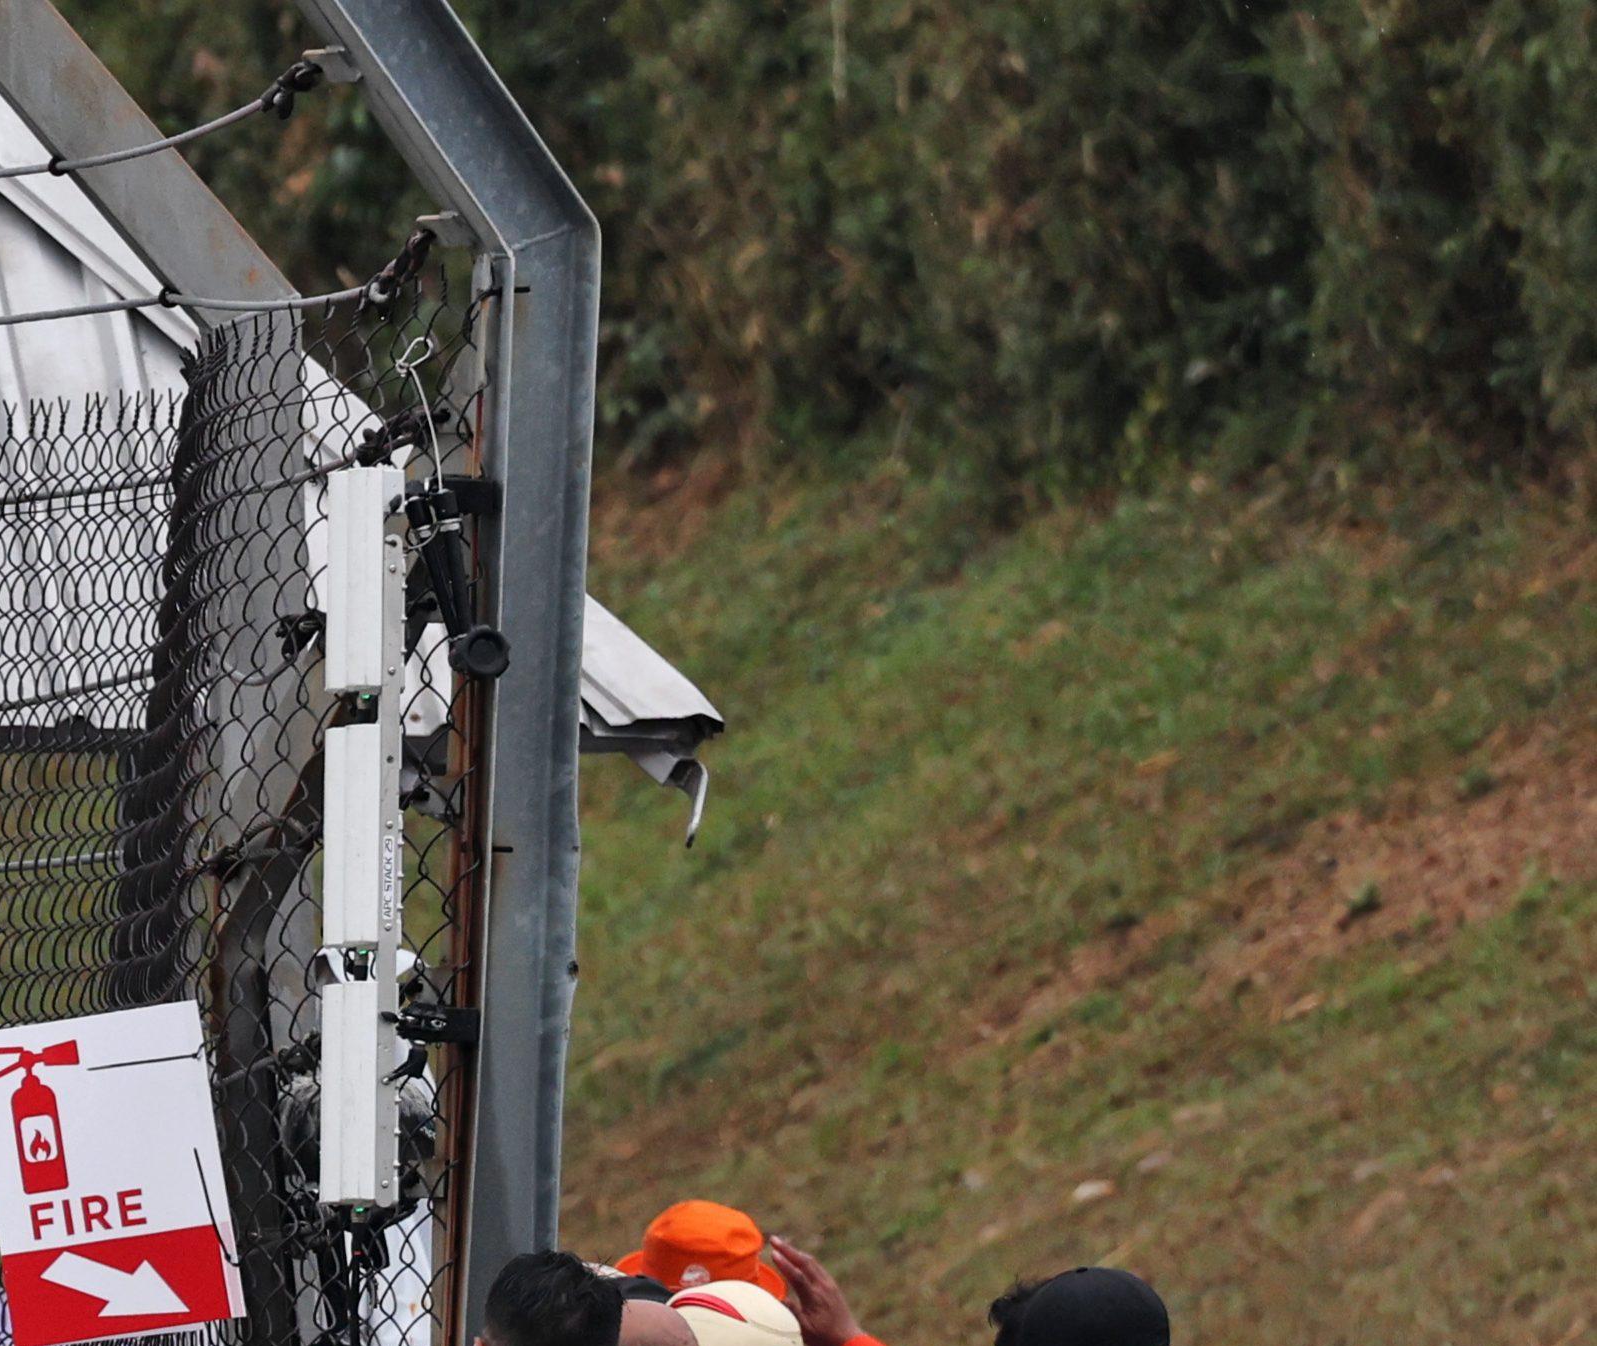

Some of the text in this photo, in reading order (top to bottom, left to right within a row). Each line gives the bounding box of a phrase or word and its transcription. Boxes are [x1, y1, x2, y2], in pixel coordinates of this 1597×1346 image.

[383, 856, 392, 892] STACK
[383, 894, 392, 919] APC
[29, 1188, 147, 1241] FIRE
